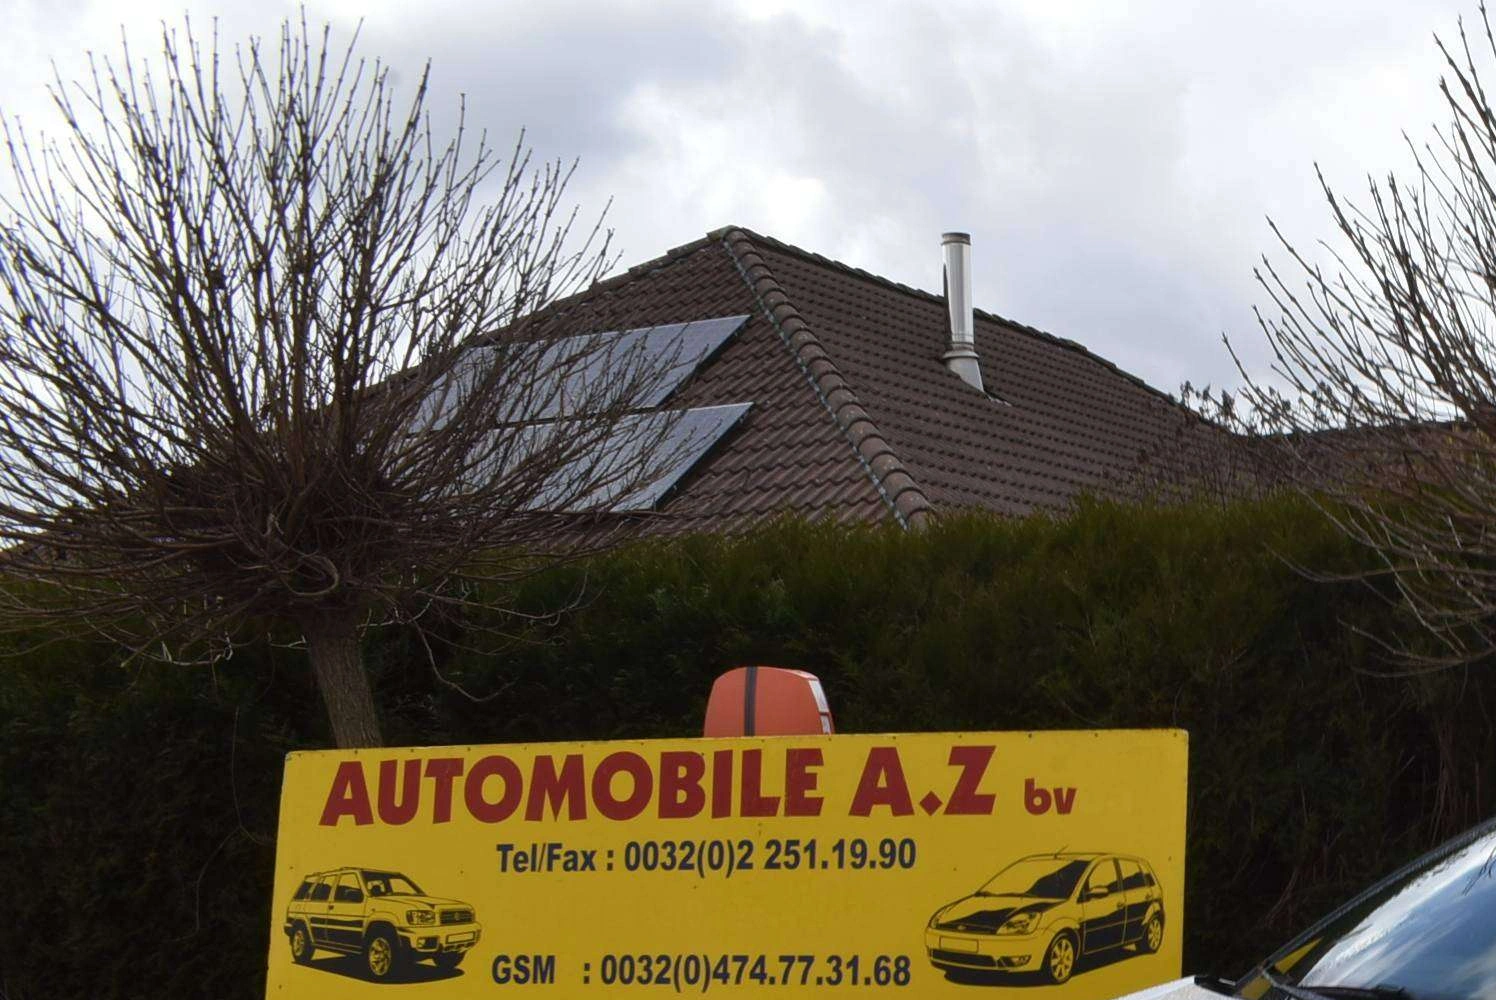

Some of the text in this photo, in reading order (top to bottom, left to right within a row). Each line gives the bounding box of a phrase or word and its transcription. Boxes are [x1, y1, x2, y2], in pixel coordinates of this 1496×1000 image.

[319, 745, 1077, 826] AUTOMOBILE A.Z bv
[496, 843, 597, 873] Tel/Fax
[624, 839, 754, 879] 0032(0)2
[763, 838, 917, 871] 251.19.90
[491, 954, 556, 986] GSM
[600, 954, 912, 993] 0032(0)474.77.31.68
